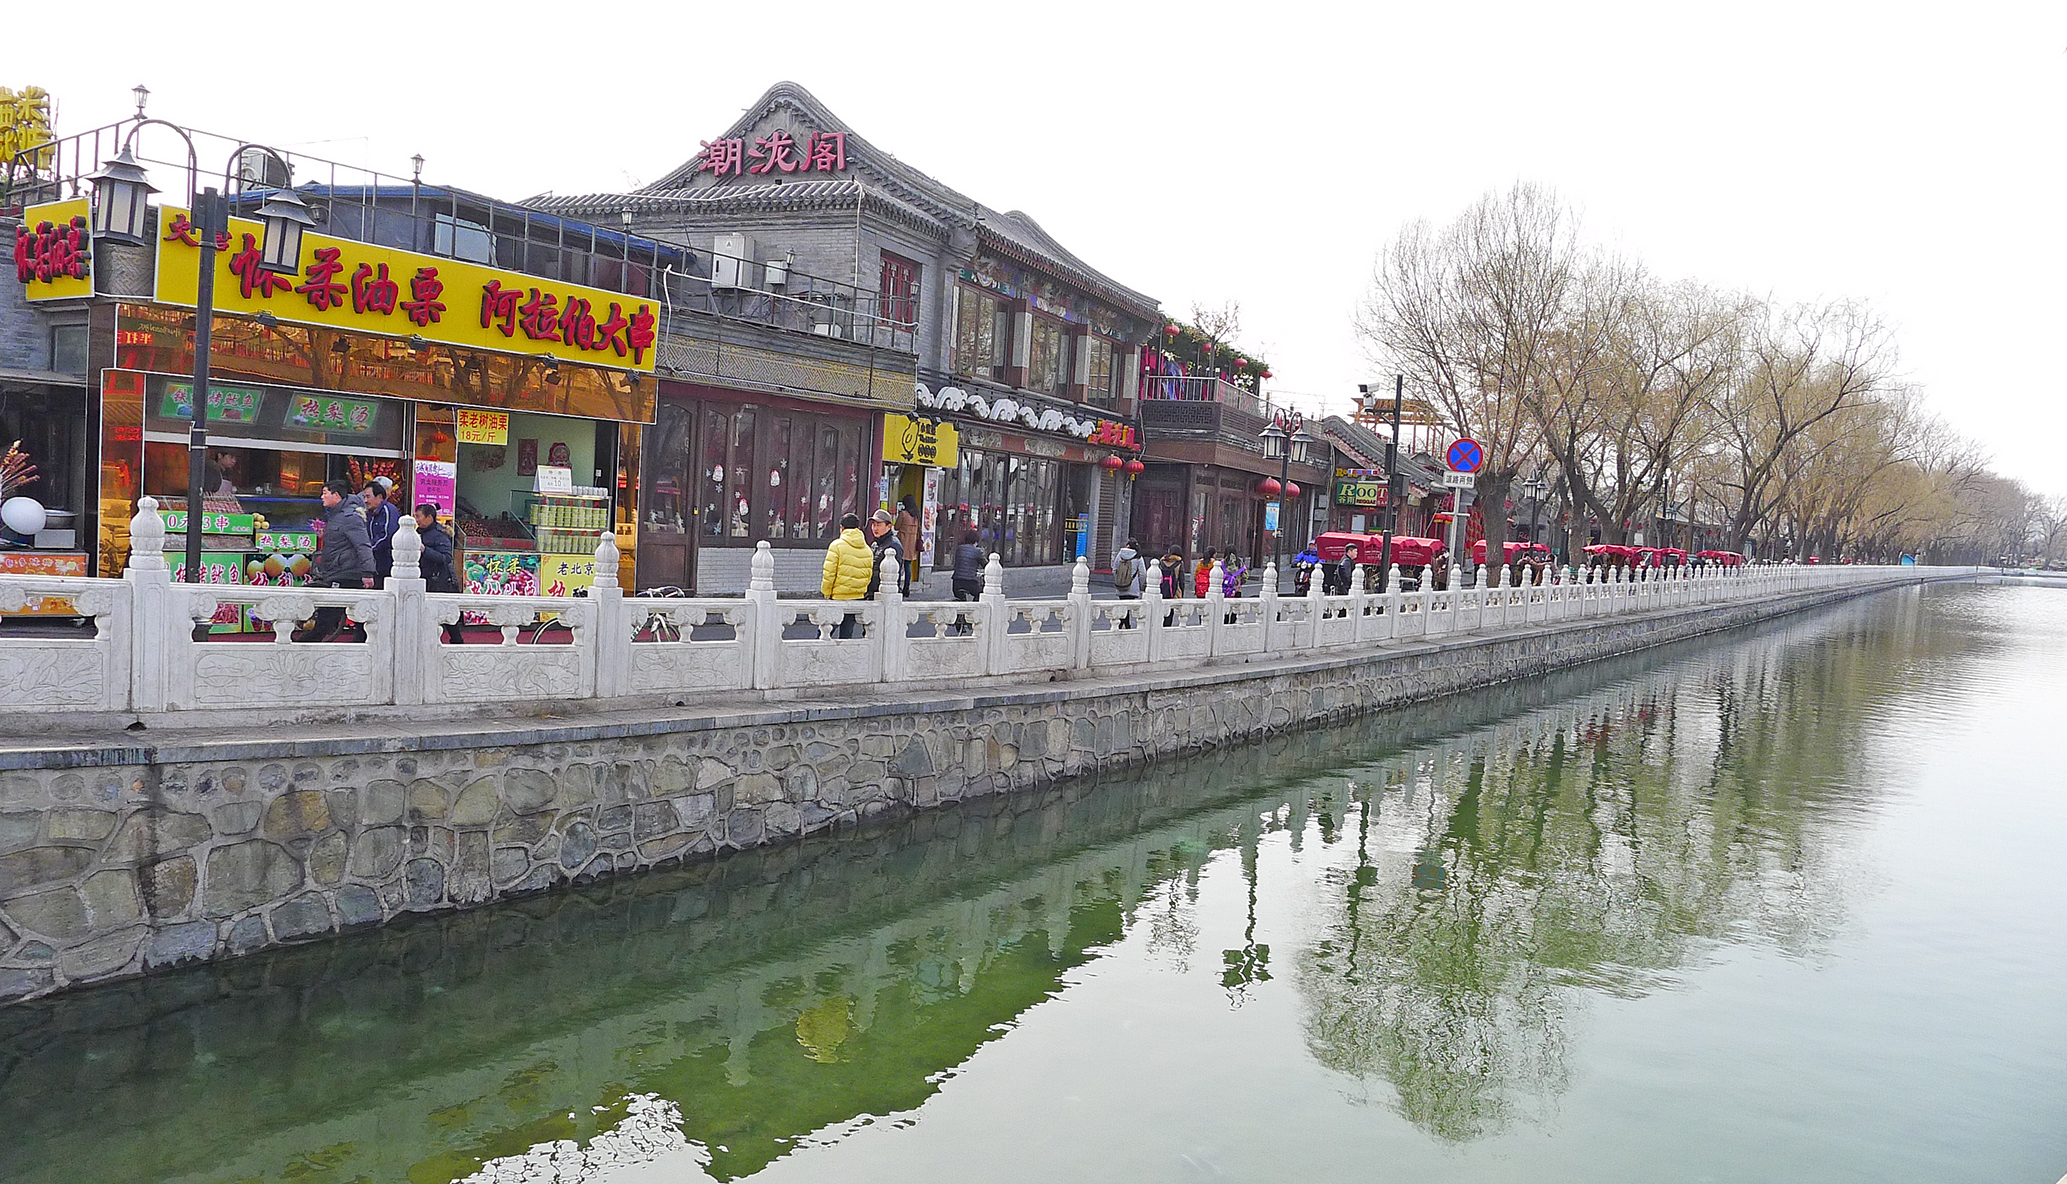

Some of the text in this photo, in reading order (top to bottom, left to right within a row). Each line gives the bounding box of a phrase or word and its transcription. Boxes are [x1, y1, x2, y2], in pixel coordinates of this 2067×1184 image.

[698, 131, 846, 177] 潮泷阁
[480, 279, 656, 365] 阿拉伯大串
[459, 410, 508, 431] 柔老树油栗
[461, 430, 496, 442] 18元/斤
[486, 557, 522, 576] 怀柔
[557, 561, 594, 576] 老北京
